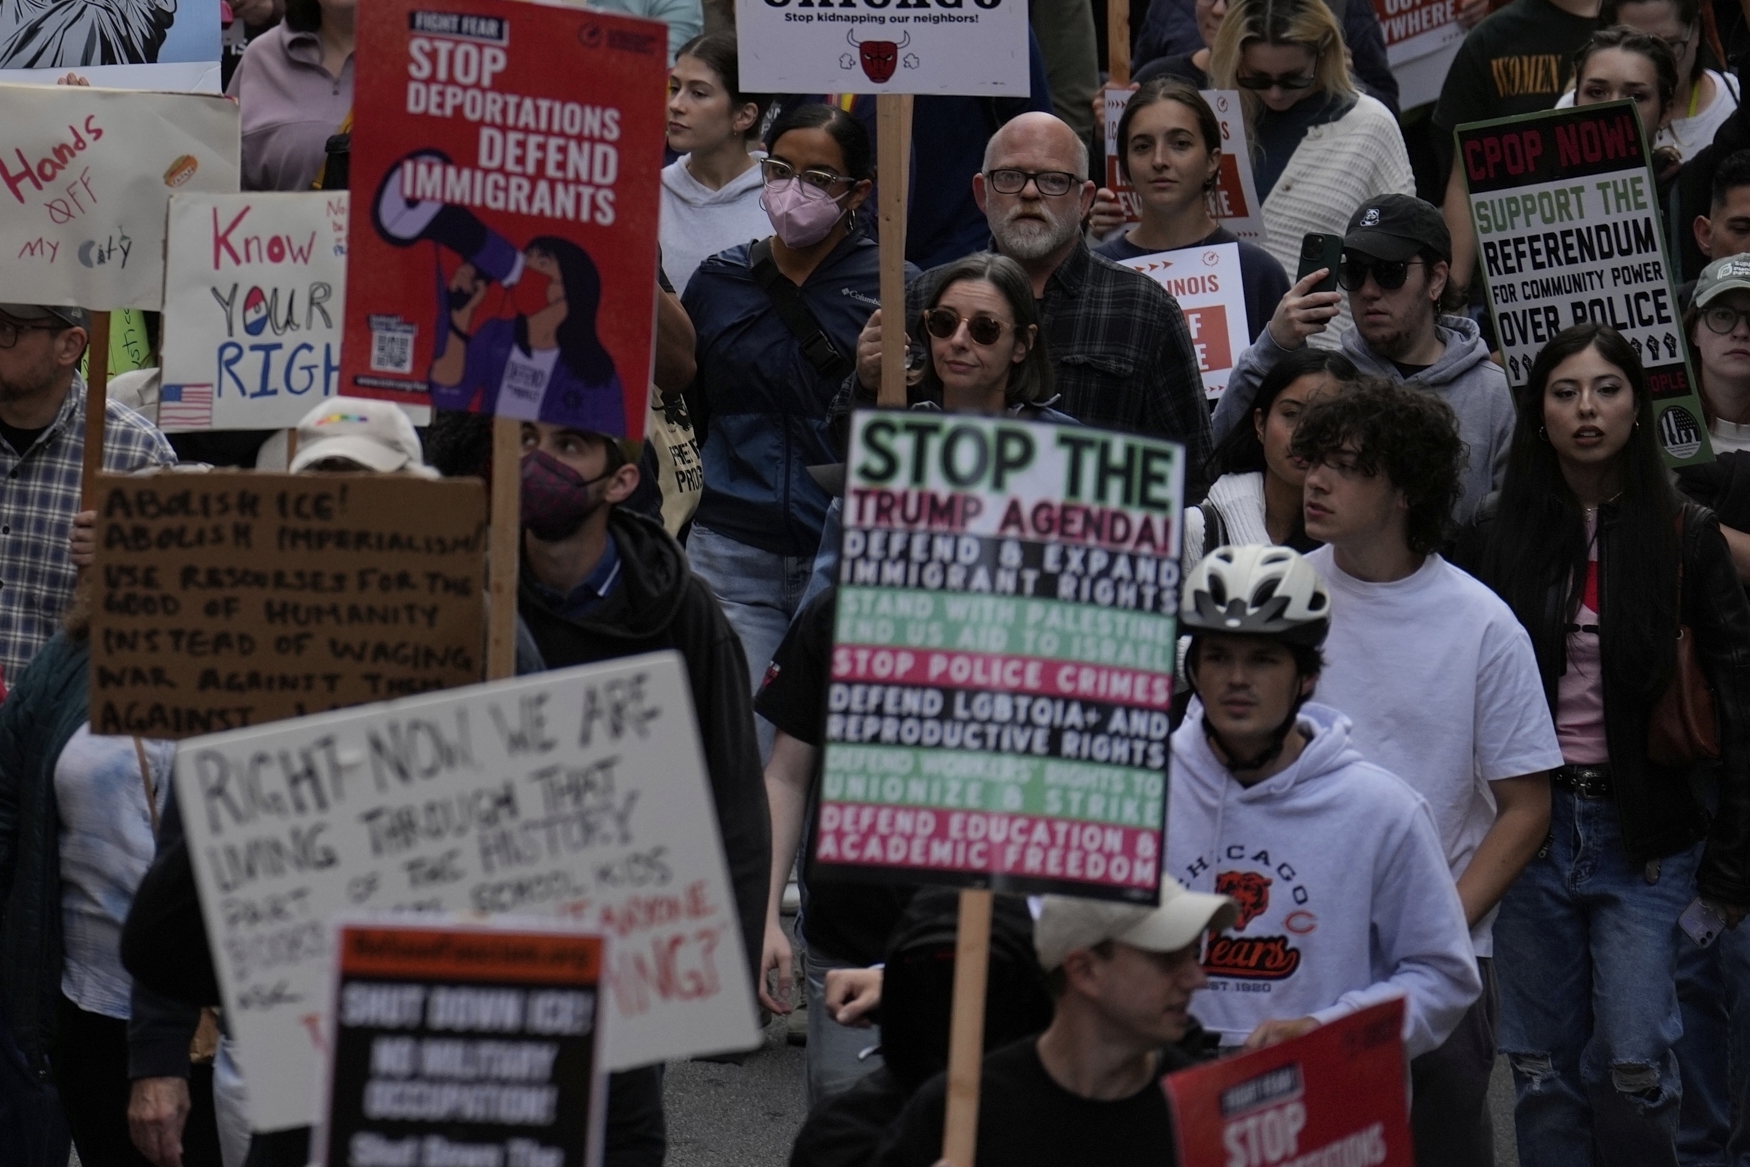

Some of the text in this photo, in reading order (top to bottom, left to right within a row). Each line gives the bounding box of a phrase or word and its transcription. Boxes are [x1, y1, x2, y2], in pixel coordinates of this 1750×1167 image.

[785, 12, 978, 25] Stop kidnapping our neighbors!
[408, 38, 508, 88] STOP
[1491, 54, 1562, 97] WOMEN
[407, 82, 621, 140] DEPORTATIONS
[479, 127, 618, 185] DEFEND
[1464, 116, 1638, 182] CPOP NOW!
[402, 160, 616, 226] IMMIGRANTS
[1475, 176, 1647, 235] SUPPORT THE
[1483, 217, 1657, 276] REFERENDUM
[211, 281, 333, 337] YOUR
[1492, 261, 1664, 305] FOR COMMUNITY POWER
[1498, 288, 1672, 347] OVER POLICE
[856, 418, 1174, 511] STOP THE
